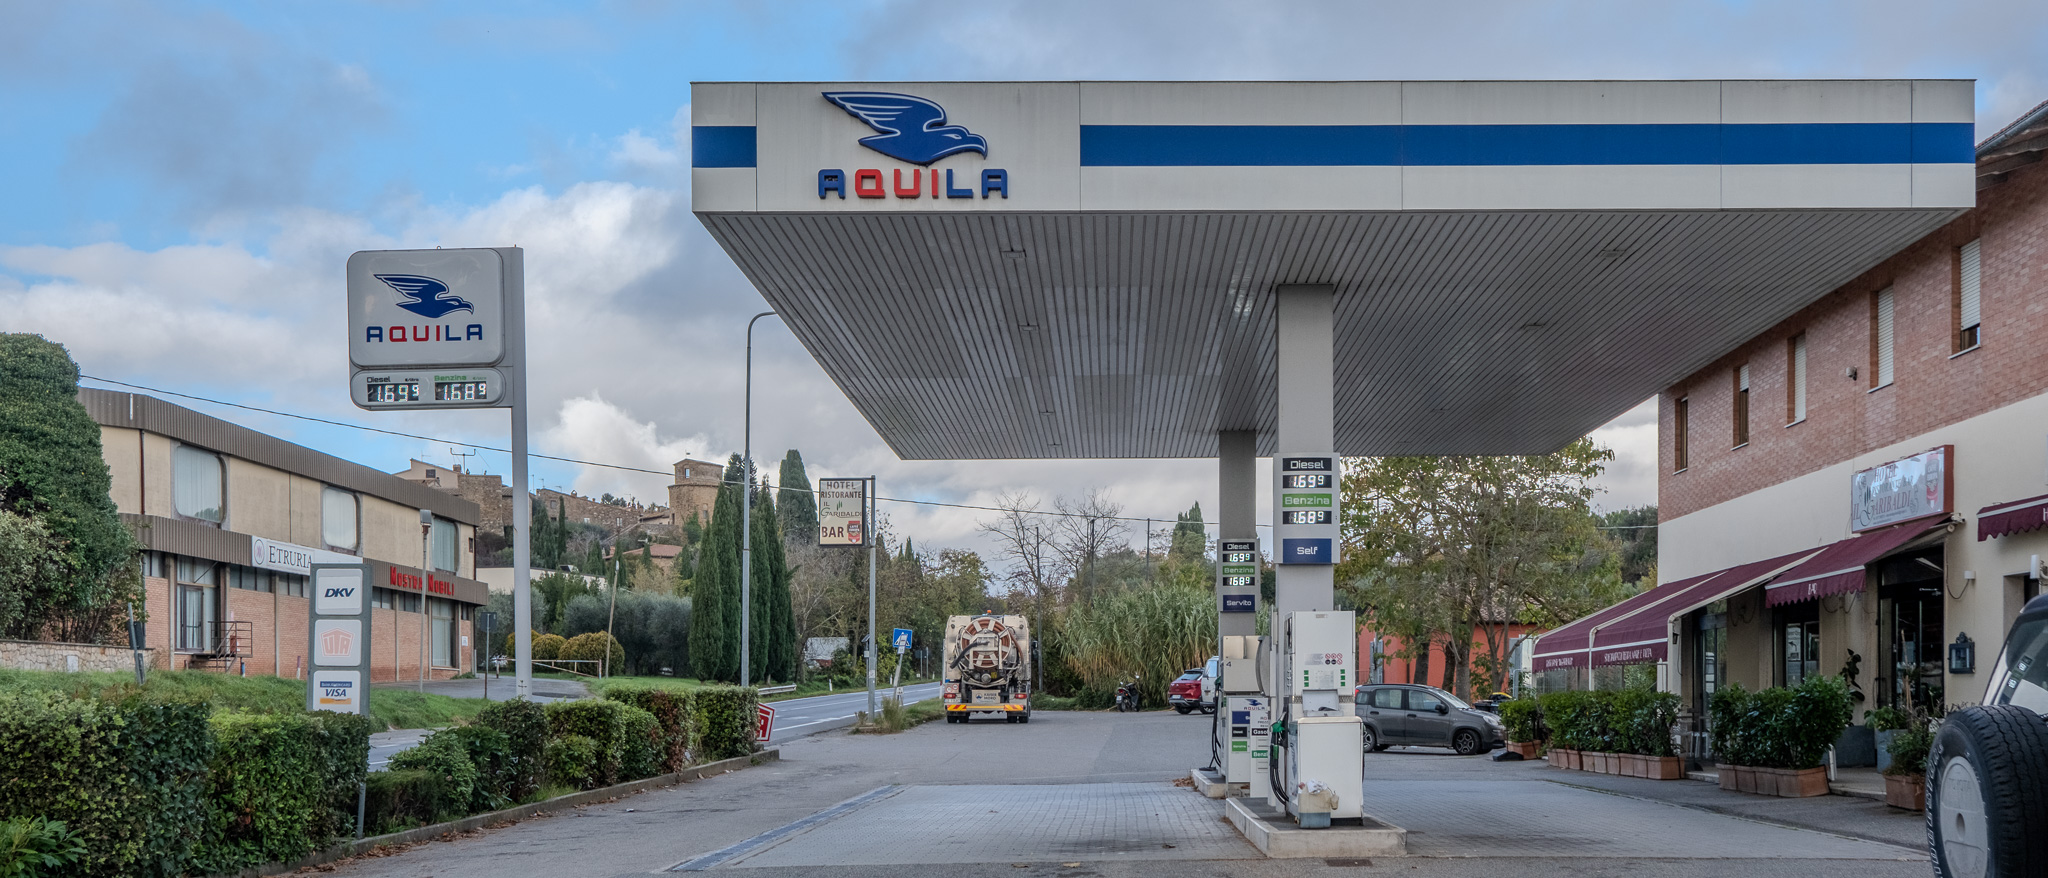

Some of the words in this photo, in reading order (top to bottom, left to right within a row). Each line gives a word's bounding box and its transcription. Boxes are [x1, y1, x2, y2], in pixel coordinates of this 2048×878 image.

[818, 168, 1008, 199] AQUILA
[366, 324, 483, 343] AQUILA
[1290, 460, 1324, 469] Diesel
[826, 482, 856, 490] HOTEL
[821, 491, 862, 499] RISTORANTE
[1284, 496, 1330, 505] Benzina
[821, 507, 862, 519] GARIBALDI
[1860, 489, 1911, 527] GARIBALDI
[822, 526, 844, 538] BAR
[1297, 546, 1318, 555] Self
[268, 545, 313, 569] ETRURIA
[324, 588, 355, 598] DKV
[322, 630, 354, 655] UTA
[325, 689, 347, 697] VISA
